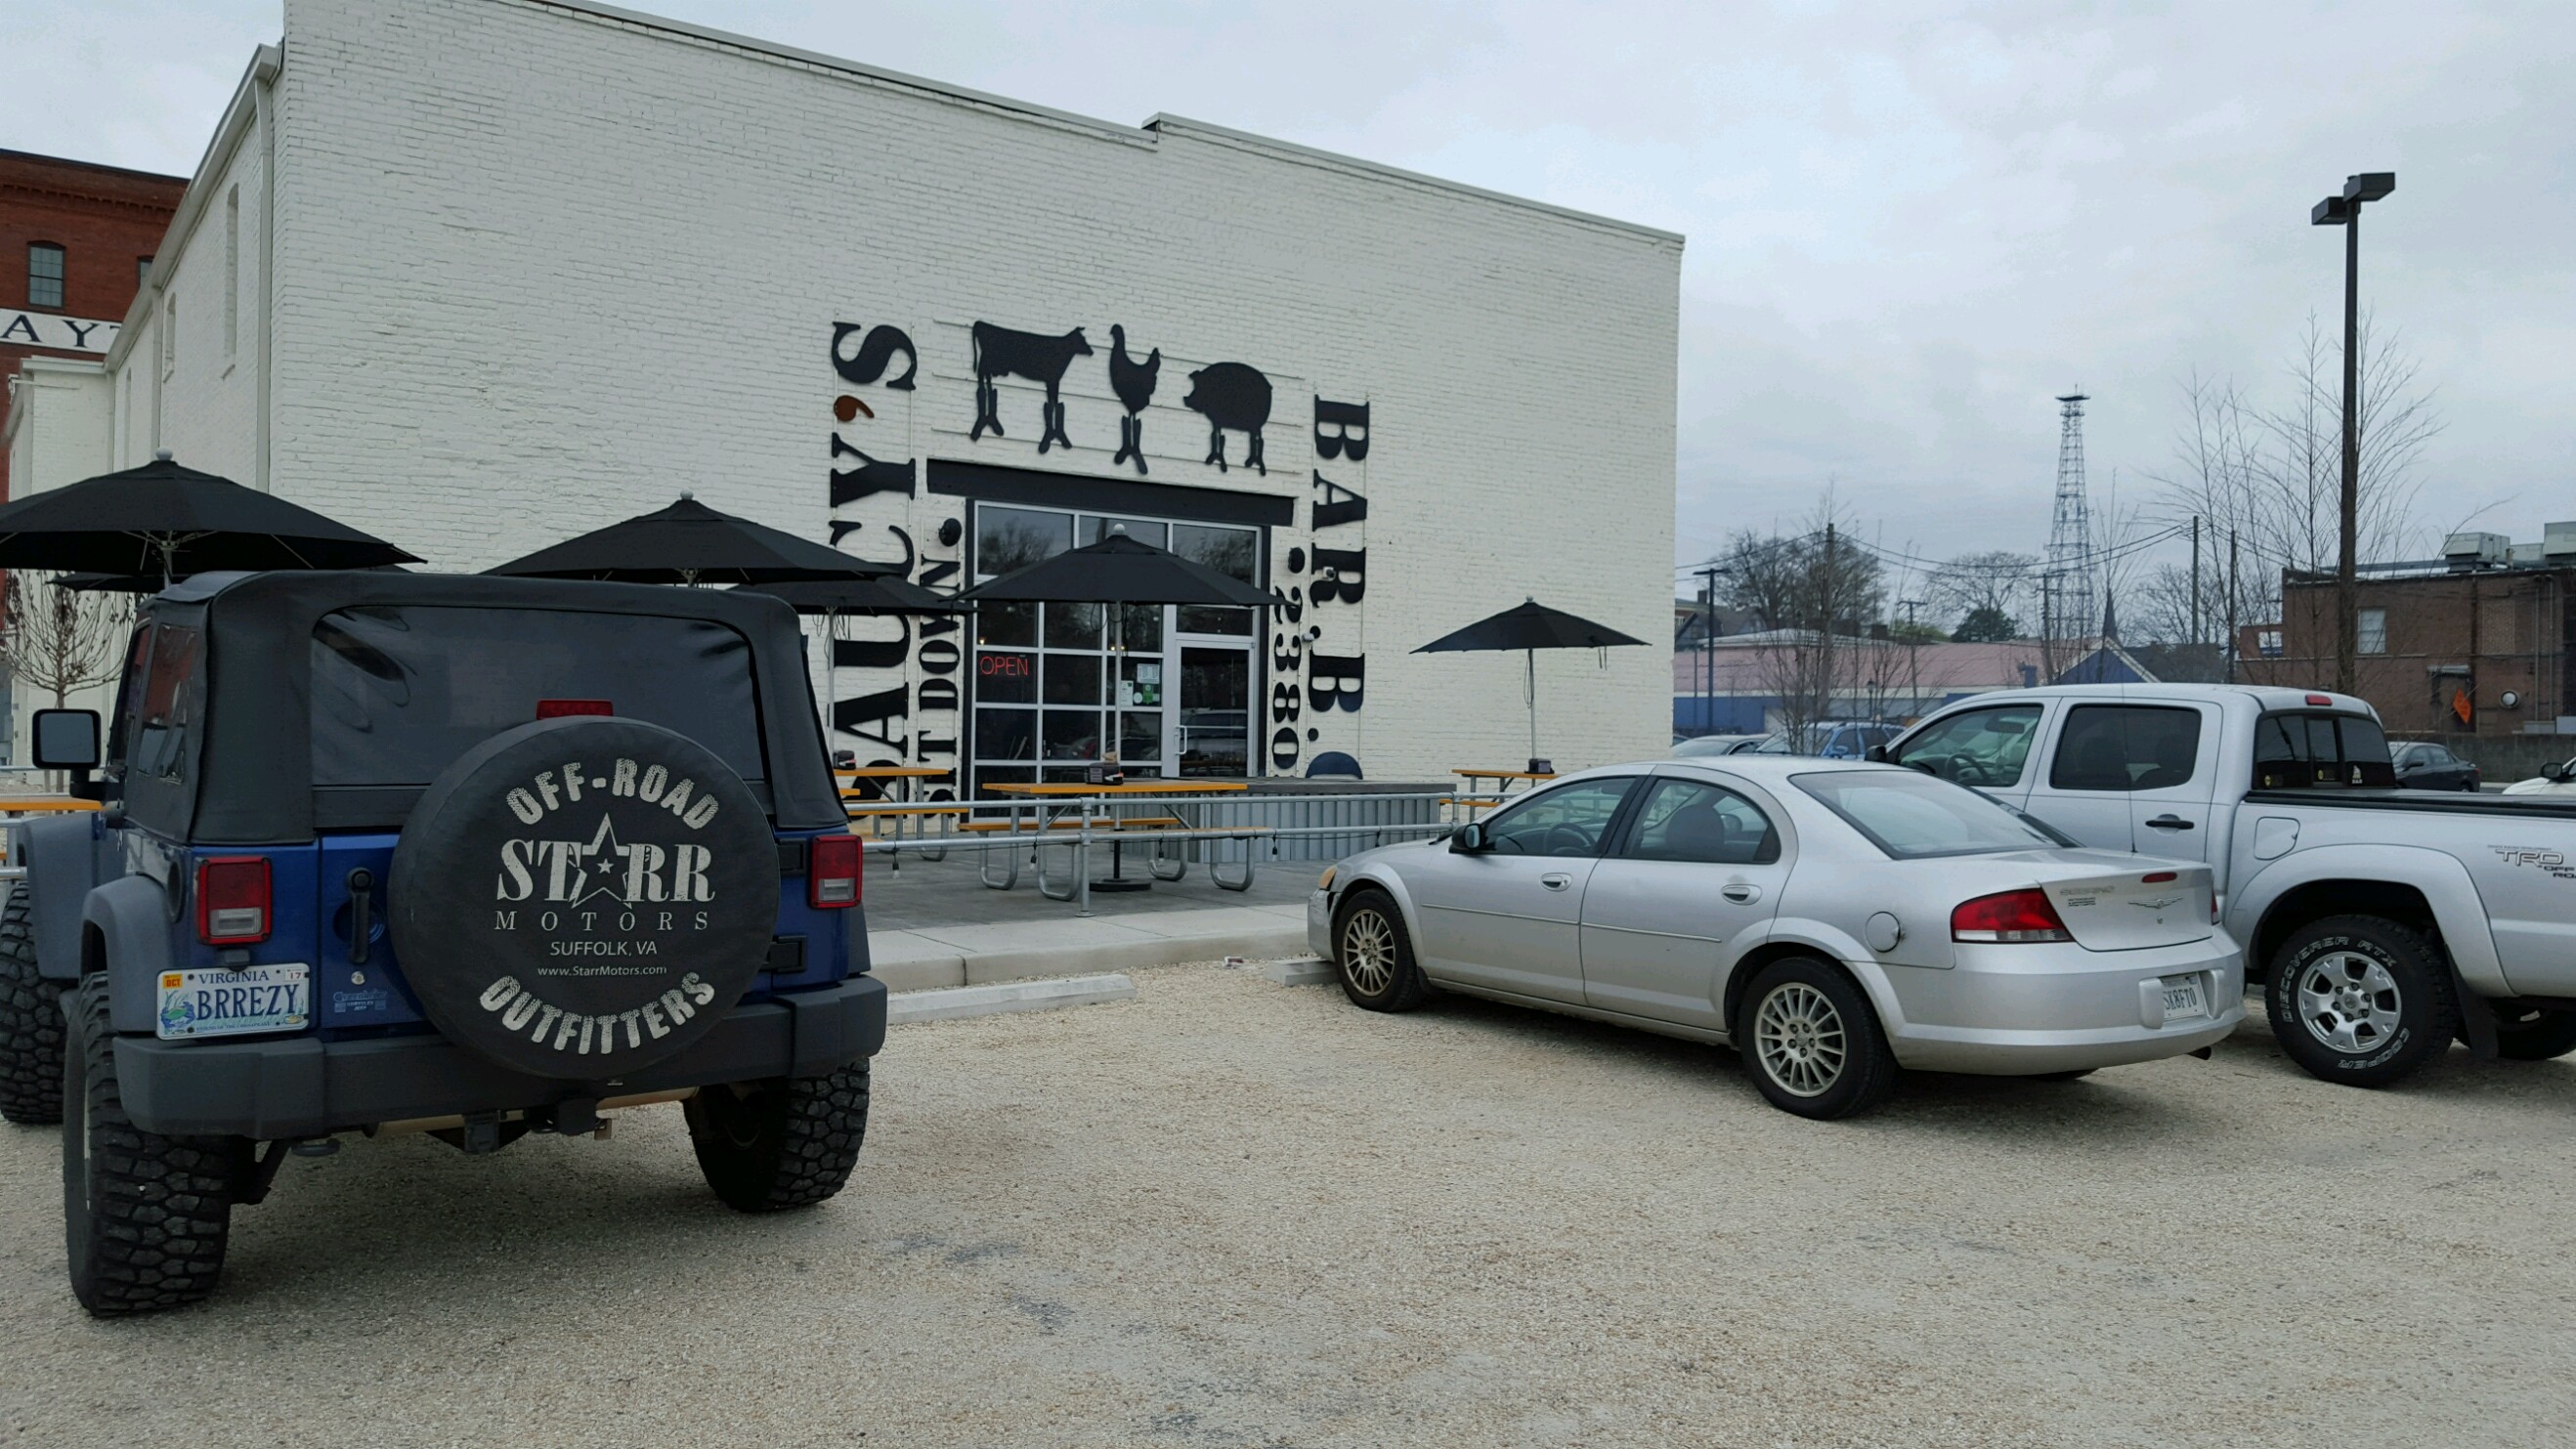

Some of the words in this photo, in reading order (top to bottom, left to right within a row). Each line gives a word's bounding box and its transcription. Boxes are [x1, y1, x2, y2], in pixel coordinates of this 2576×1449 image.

[0, 314, 121, 349] AY
[980, 656, 1029, 676] OPEN
[506, 758, 719, 830] OFF-ROAD
[2495, 849, 2564, 868] TRD
[494, 911, 708, 931] MOTORS
[550, 940, 632, 957] SUFFOLK,
[636, 941, 658, 956] VA
[198, 970, 269, 984] VIRGINIA
[537, 964, 667, 977] www.StarrMotors.com
[2279, 936, 2349, 1023] DISCOVERER
[197, 984, 299, 1021] BRREZY
[480, 972, 715, 1054] OUTFITTERS
[2339, 1027, 2410, 1070] COOPER
